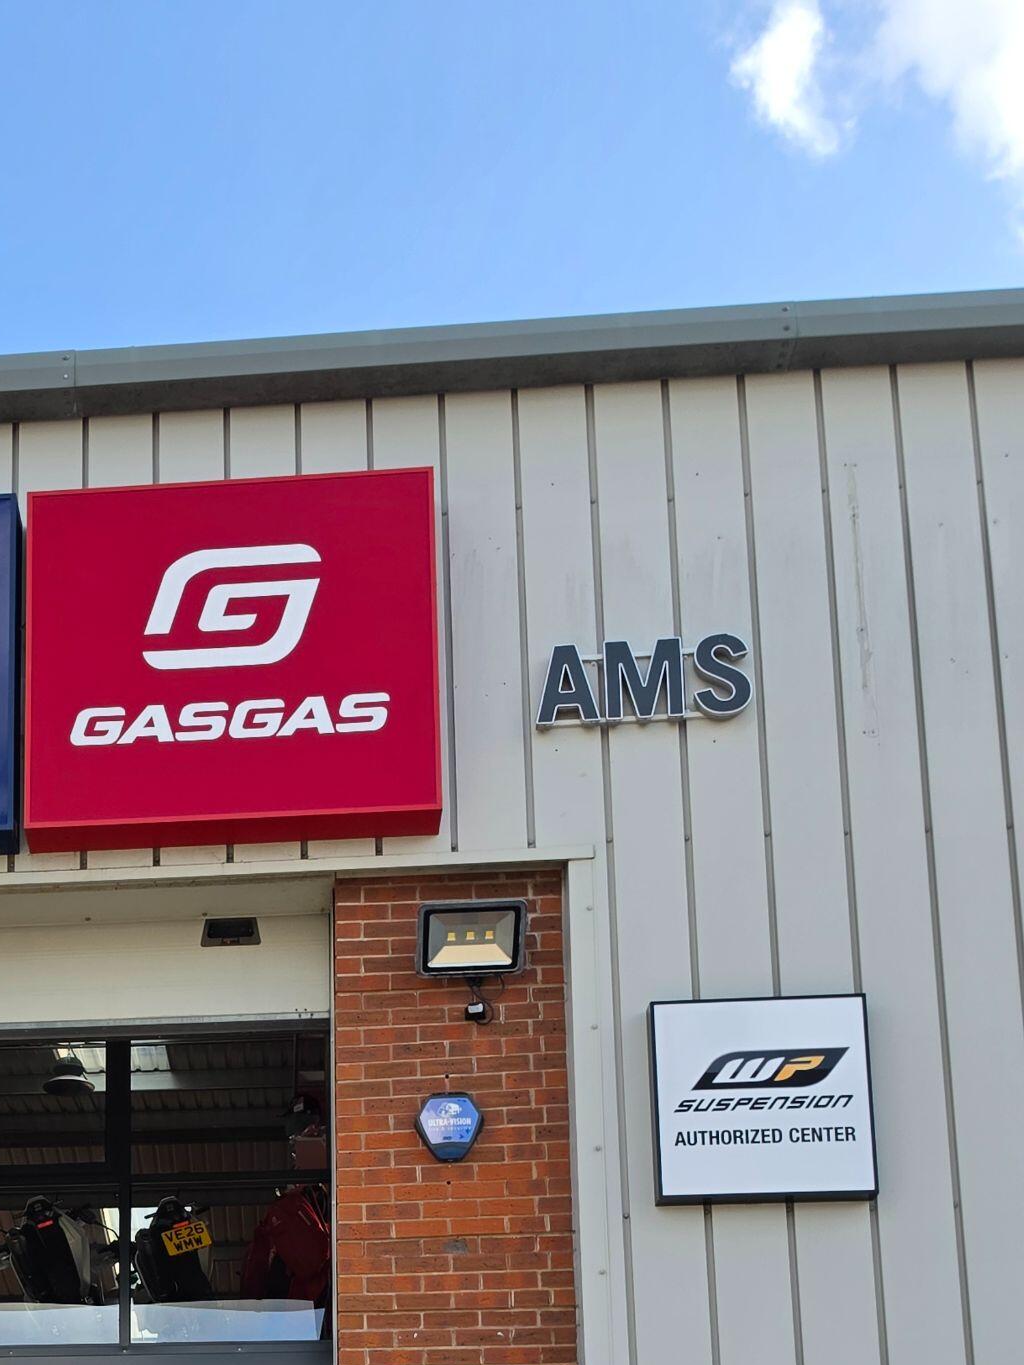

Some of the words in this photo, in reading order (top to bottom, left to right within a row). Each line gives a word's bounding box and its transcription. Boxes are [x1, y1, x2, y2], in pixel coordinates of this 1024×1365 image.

[536, 633, 753, 727] AMS
[69, 692, 391, 747] GASGAS
[711, 1055, 826, 1084] WP
[674, 1094, 854, 1113] SUSPENSION
[427, 1117, 472, 1127] ULTRA-VISION
[674, 1128, 783, 1147] AUTHORIZED
[788, 1126, 857, 1143] CENTER
